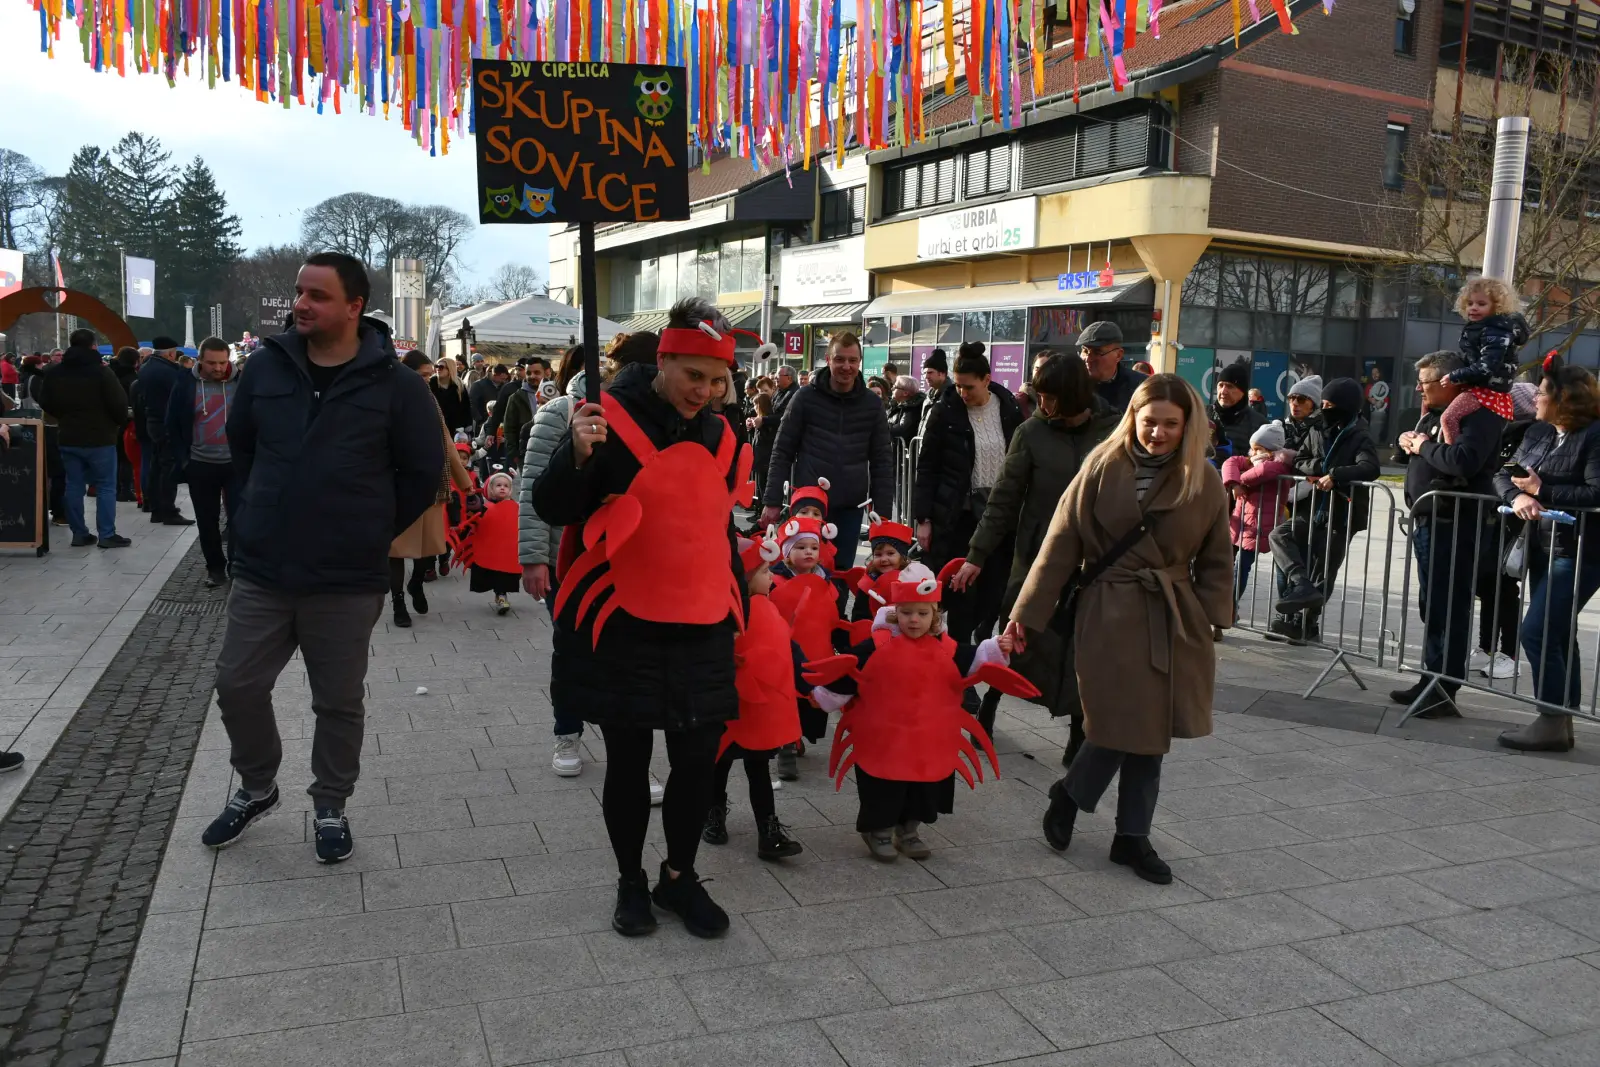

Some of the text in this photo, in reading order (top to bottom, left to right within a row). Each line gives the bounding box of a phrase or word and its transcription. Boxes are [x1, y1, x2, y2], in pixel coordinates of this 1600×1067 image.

[510, 62, 610, 78] DV CIPELICA
[478, 70, 676, 169] SKUPINA
[485, 125, 660, 221] SOVICE
[963, 208, 998, 228] URBIA
[928, 227, 1021, 256] urbi et orbi 25
[1058, 271, 1098, 291] ERSTE
[262, 297, 290, 308] DJEČJI
